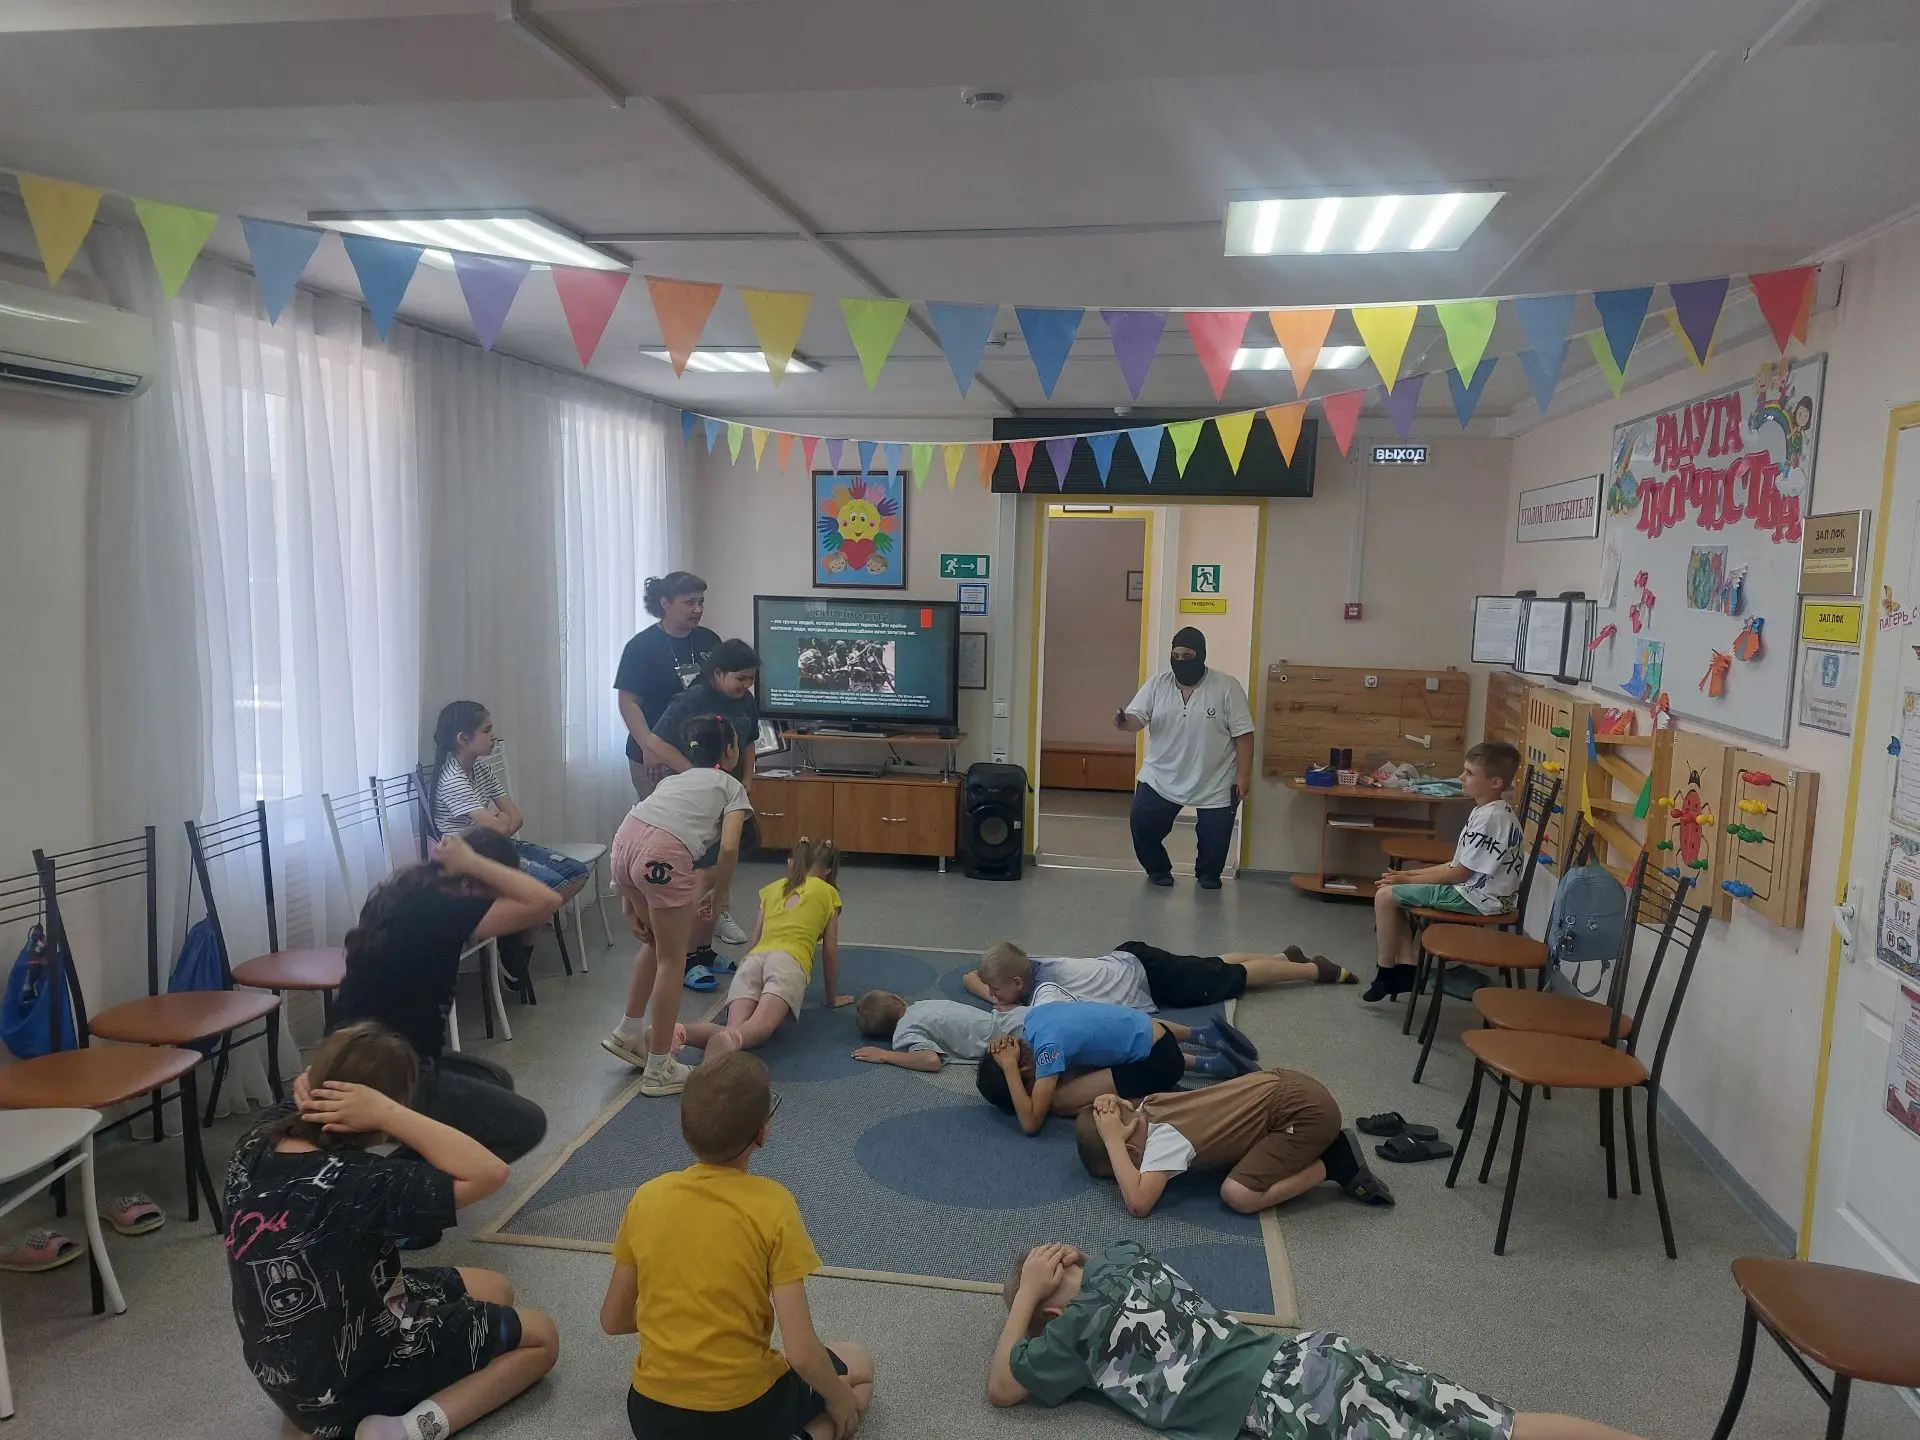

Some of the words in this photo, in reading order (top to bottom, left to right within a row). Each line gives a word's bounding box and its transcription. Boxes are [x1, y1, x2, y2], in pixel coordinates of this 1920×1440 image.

[1653, 391, 1745, 473] РАДУГА
[1376, 449, 1425, 461] ВЫХОД
[1544, 496, 1595, 523] ПОТРЕБИТЕЛЯ
[1815, 529, 1829, 541] ЗАЛ
[1830, 528, 1846, 540] ЛФК
[1819, 613, 1831, 623] ЗАЛ
[1831, 614, 1844, 624] ЛФК
